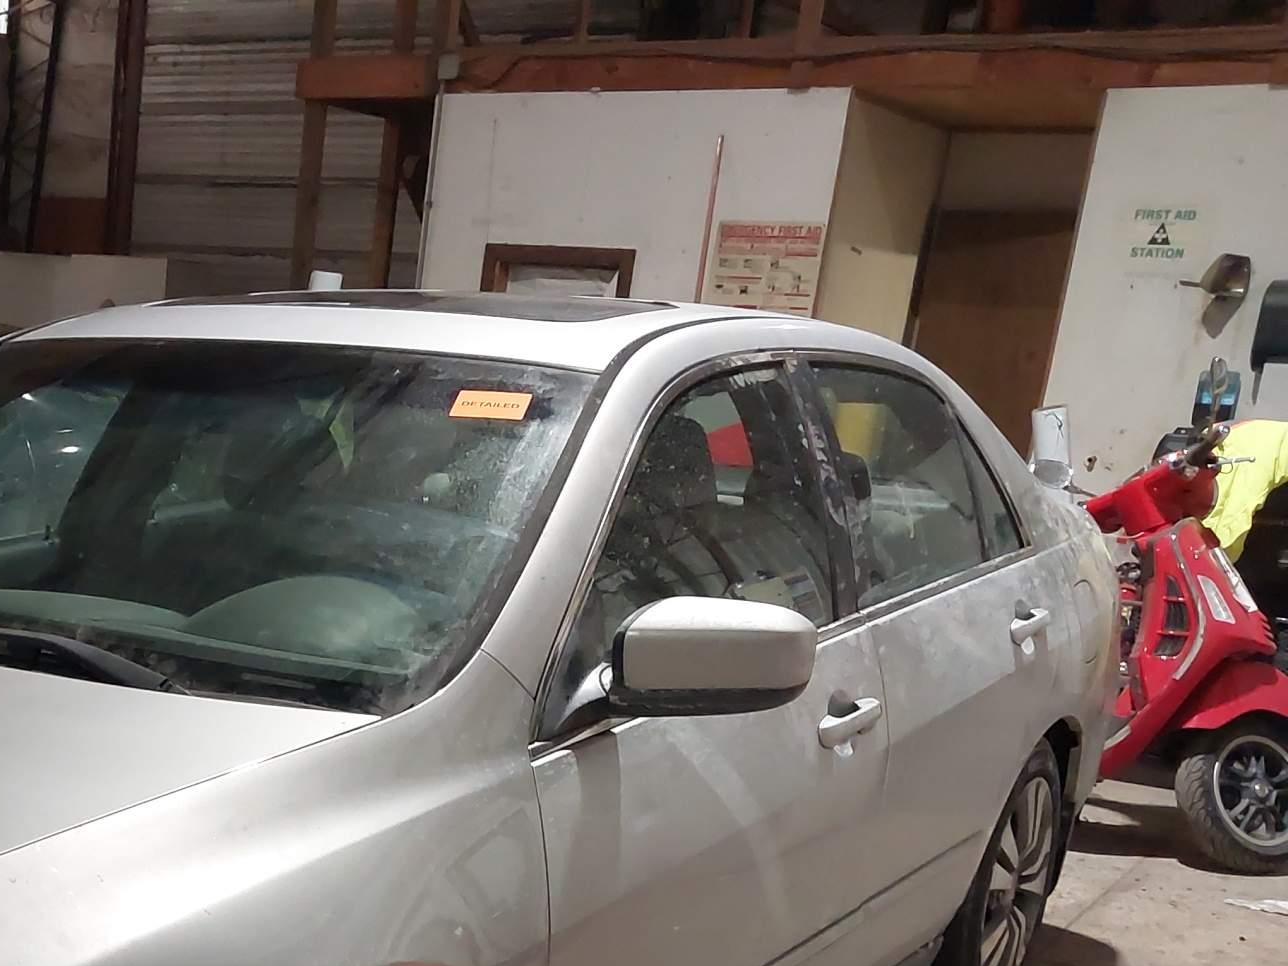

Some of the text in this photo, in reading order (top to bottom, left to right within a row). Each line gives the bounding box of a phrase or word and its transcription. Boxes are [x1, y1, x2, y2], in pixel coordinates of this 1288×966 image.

[1134, 208, 1197, 221] FIRST AID
[778, 225, 804, 238] FIRST
[806, 225, 822, 238] AID
[1130, 247, 1185, 259] STATION
[461, 400, 520, 409] DETAILED
